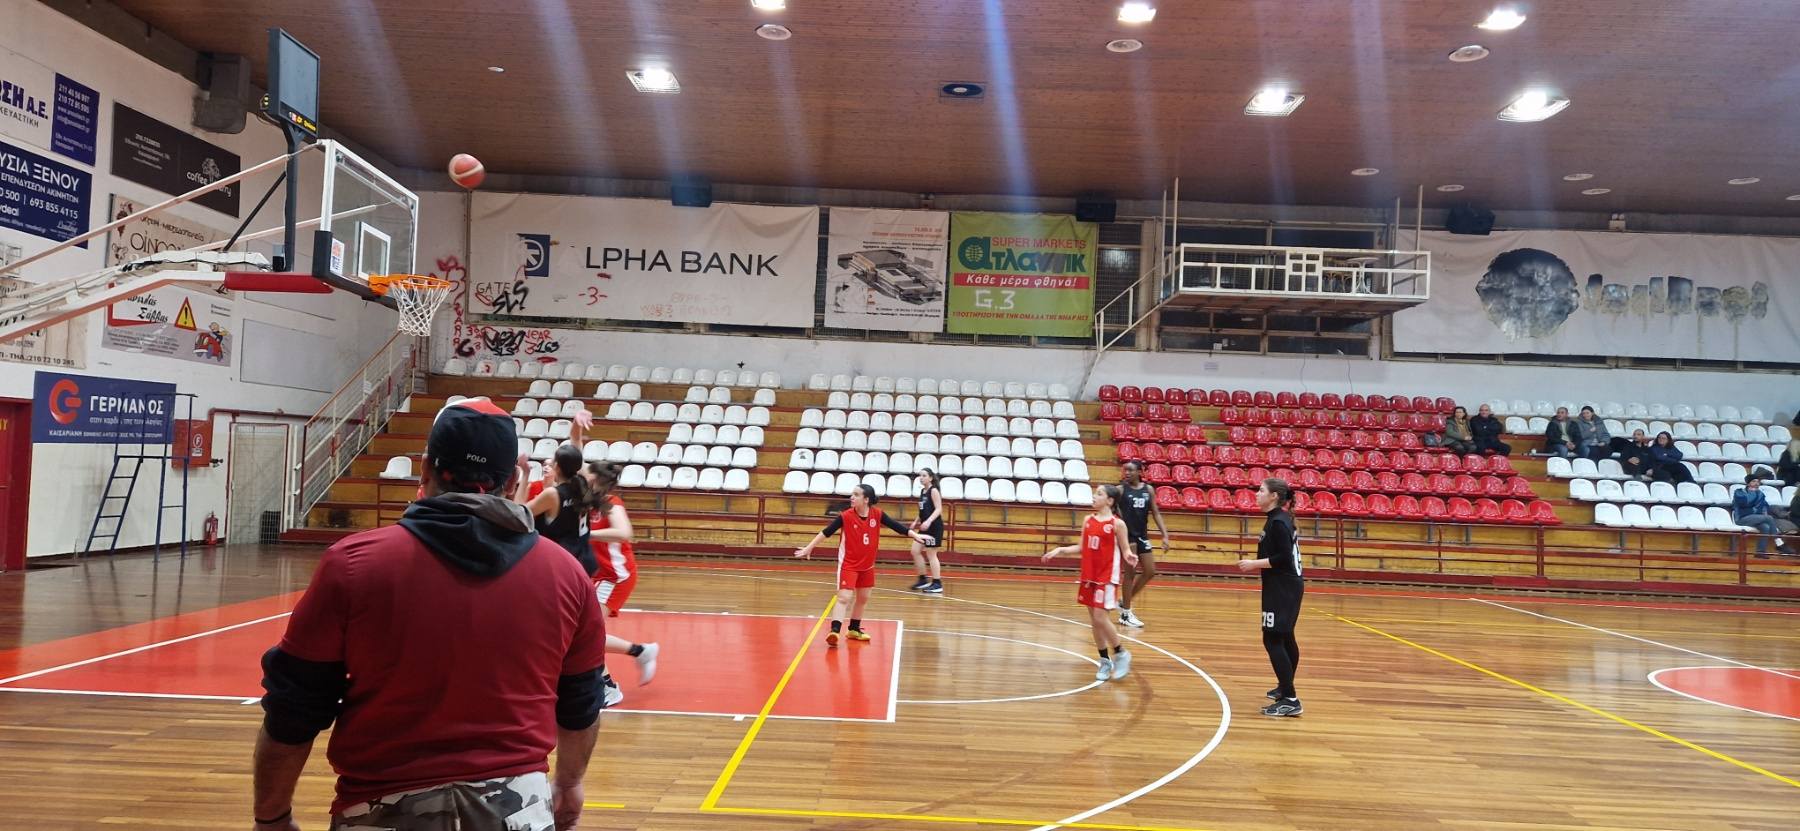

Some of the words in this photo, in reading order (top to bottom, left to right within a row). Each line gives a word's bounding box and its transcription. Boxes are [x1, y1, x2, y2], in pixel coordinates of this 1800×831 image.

[33, 163, 79, 191] ΞΕΝΟΥ
[186, 171, 208, 185] coffee
[992, 236, 1033, 248] SUPER
[1034, 238, 1087, 249] MARKETS
[680, 250, 779, 277] BANK
[476, 281, 510, 295] GATE
[966, 274, 996, 285] Κάθε
[1000, 275, 1029, 286] μέρα
[1034, 276, 1077, 288] φθηνά!
[89, 395, 164, 415] ΓΕΡΜΑΝΟΣ
[466, 453, 487, 463] POLO
[862, 534, 870, 545] 6
